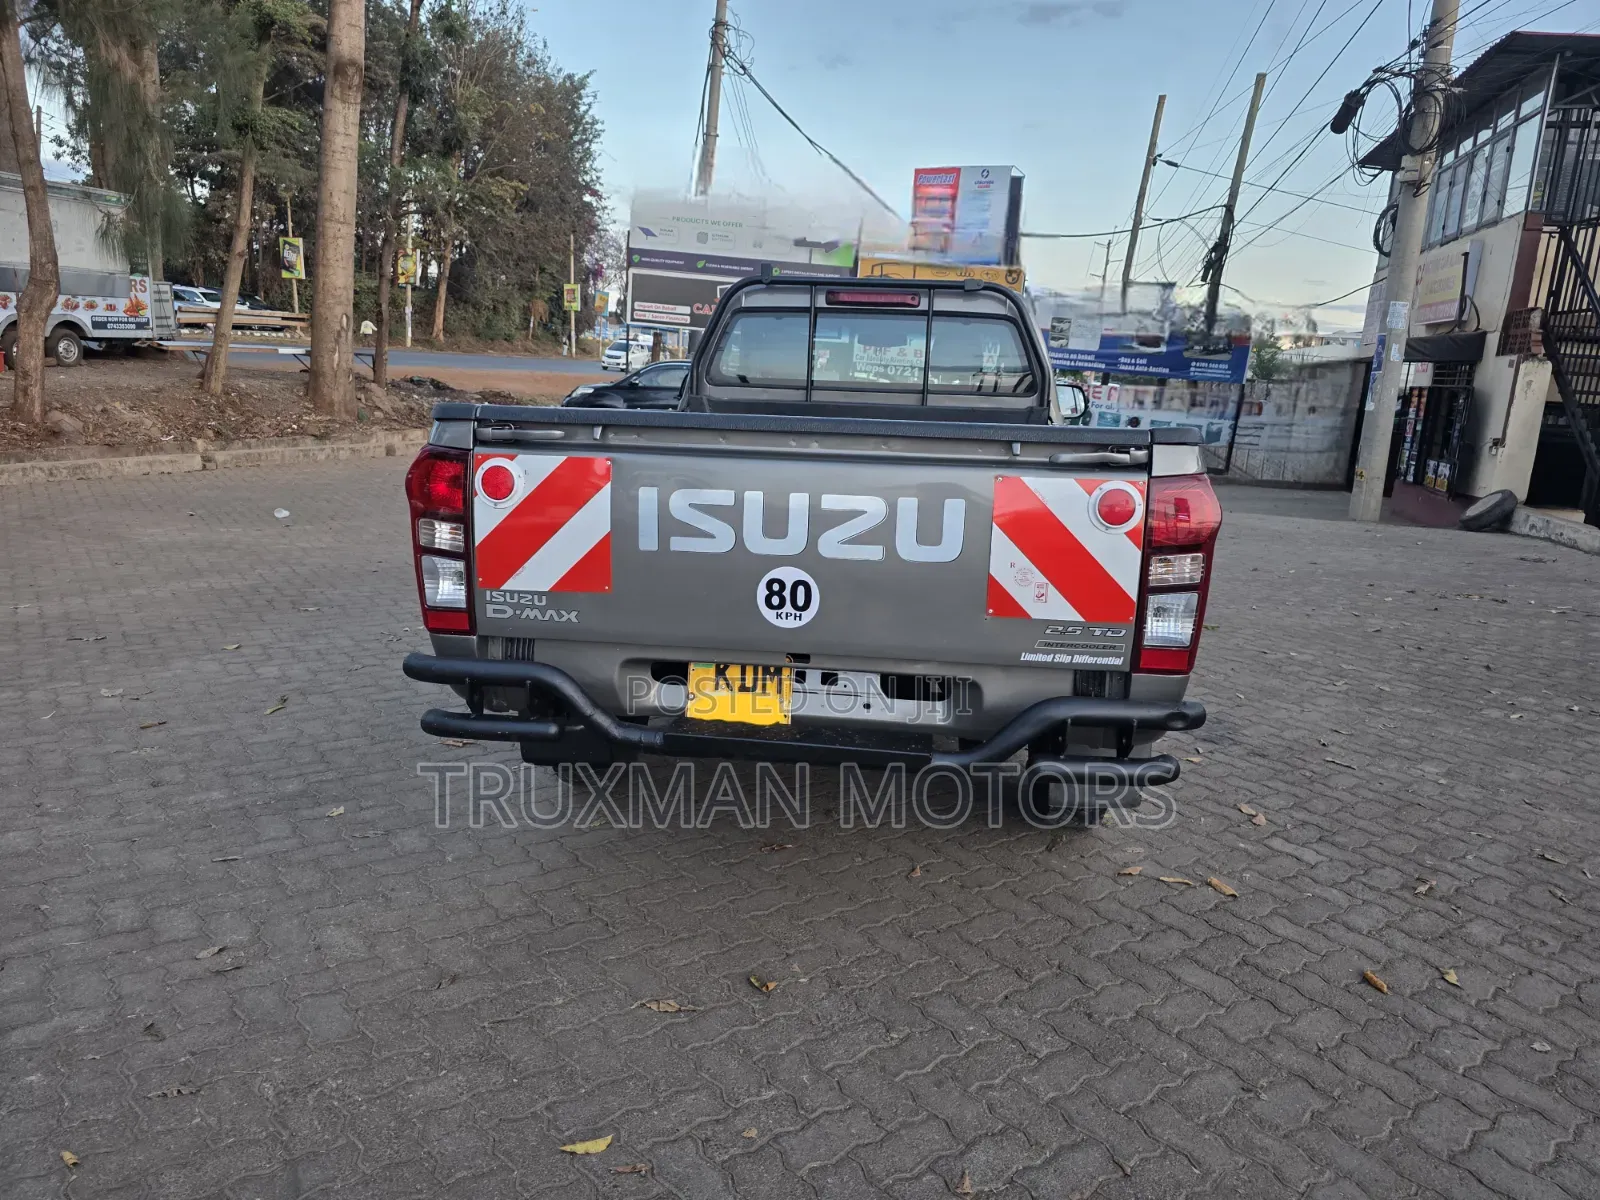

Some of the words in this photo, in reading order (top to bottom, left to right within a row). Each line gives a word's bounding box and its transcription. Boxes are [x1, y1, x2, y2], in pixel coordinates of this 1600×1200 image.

[672, 216, 709, 225] PRODUCTS
[666, 315, 688, 323] Financing
[1091, 401, 1103, 409] For
[638, 487, 966, 563] ISUZU
[485, 590, 547, 606] ISUZU
[764, 577, 813, 612] 80
[485, 603, 580, 622] D-MAX
[775, 611, 802, 622] KPH
[1044, 625, 1084, 636] 2.5
[1088, 626, 1127, 637] TD
[1043, 641, 1117, 650] INTERCOOLER
[1020, 652, 1053, 663] Limited
[1053, 653, 1072, 664] Slip
[1072, 654, 1124, 665] Differential
